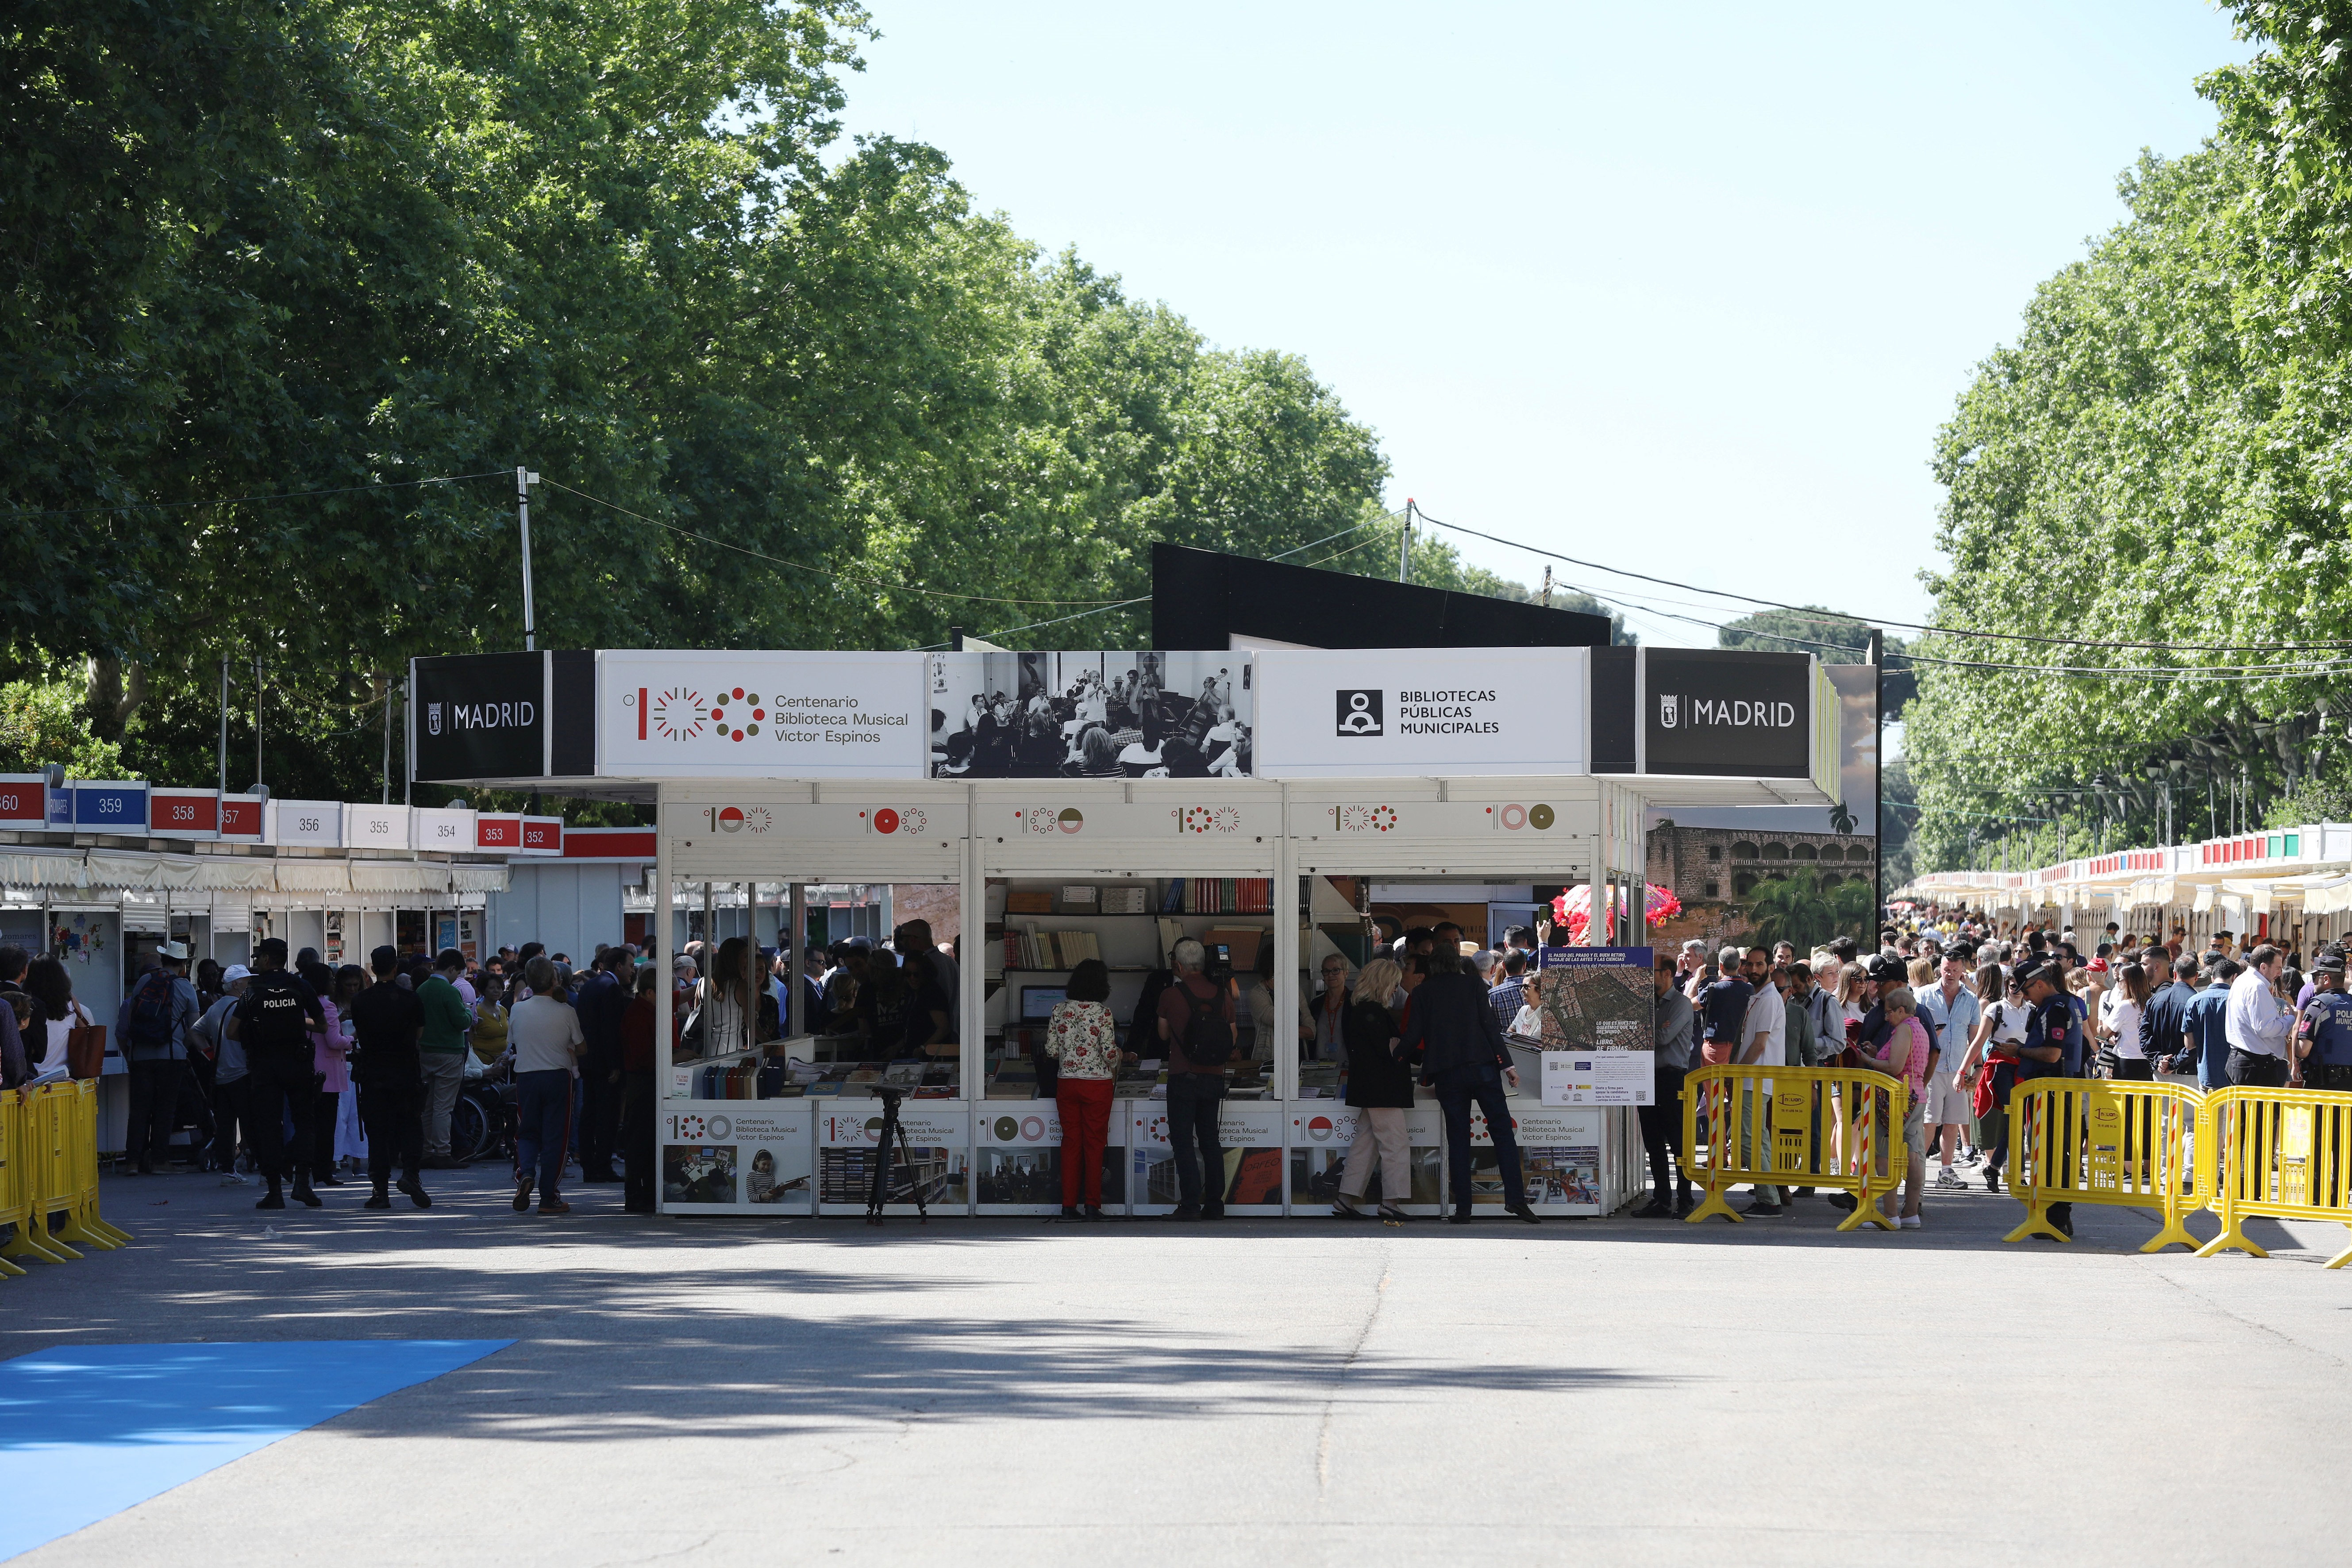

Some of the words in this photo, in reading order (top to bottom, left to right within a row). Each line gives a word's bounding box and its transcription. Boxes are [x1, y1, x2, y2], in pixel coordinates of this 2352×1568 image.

[775, 695, 858, 708] Centenario
[1401, 690, 1496, 702] BIBLIOTECAS
[454, 701, 534, 729] MADRID
[1401, 704, 1472, 718] PÚBLICAS
[1695, 699, 1795, 727] MADRID
[775, 713, 848, 726] Biblioteca
[853, 713, 908, 726] Musical
[1401, 722, 1499, 734] MUNICIPALES
[775, 729, 820, 742] Víctor
[826, 730, 880, 745] Espinós
[0, 795, 18, 810] 60
[99, 798, 122, 813] 359
[172, 805, 195, 821] 358
[299, 818, 319, 831] 356
[370, 821, 389, 834] 355
[437, 825, 455, 837] 354
[485, 828, 503, 840] 353
[527, 831, 544, 843] 352
[263, 998, 296, 1008] POLICIA
[1245, 1158, 1280, 1171] ORFEO
